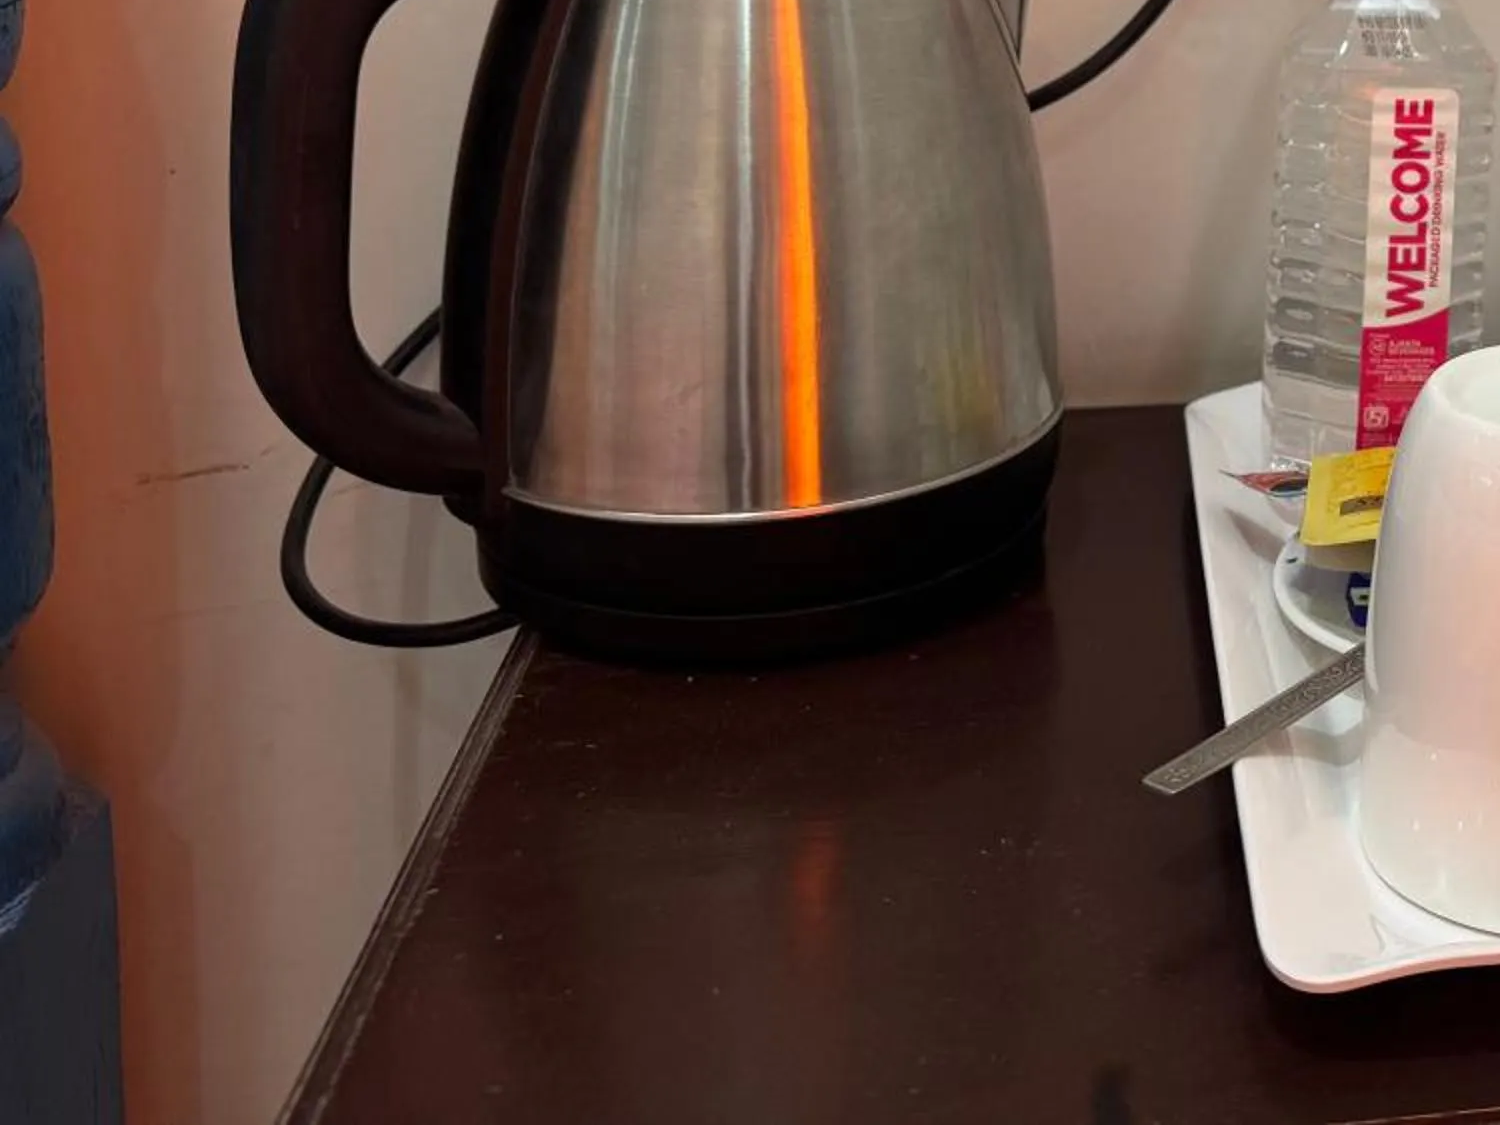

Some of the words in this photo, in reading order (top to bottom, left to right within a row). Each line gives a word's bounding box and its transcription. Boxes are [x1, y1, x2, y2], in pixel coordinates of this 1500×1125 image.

[1434, 131, 1447, 168] WATER
[1385, 98, 1435, 318] WELCOME
[1431, 170, 1444, 225] DRINKING
[1428, 226, 1442, 288] PACKAGED
